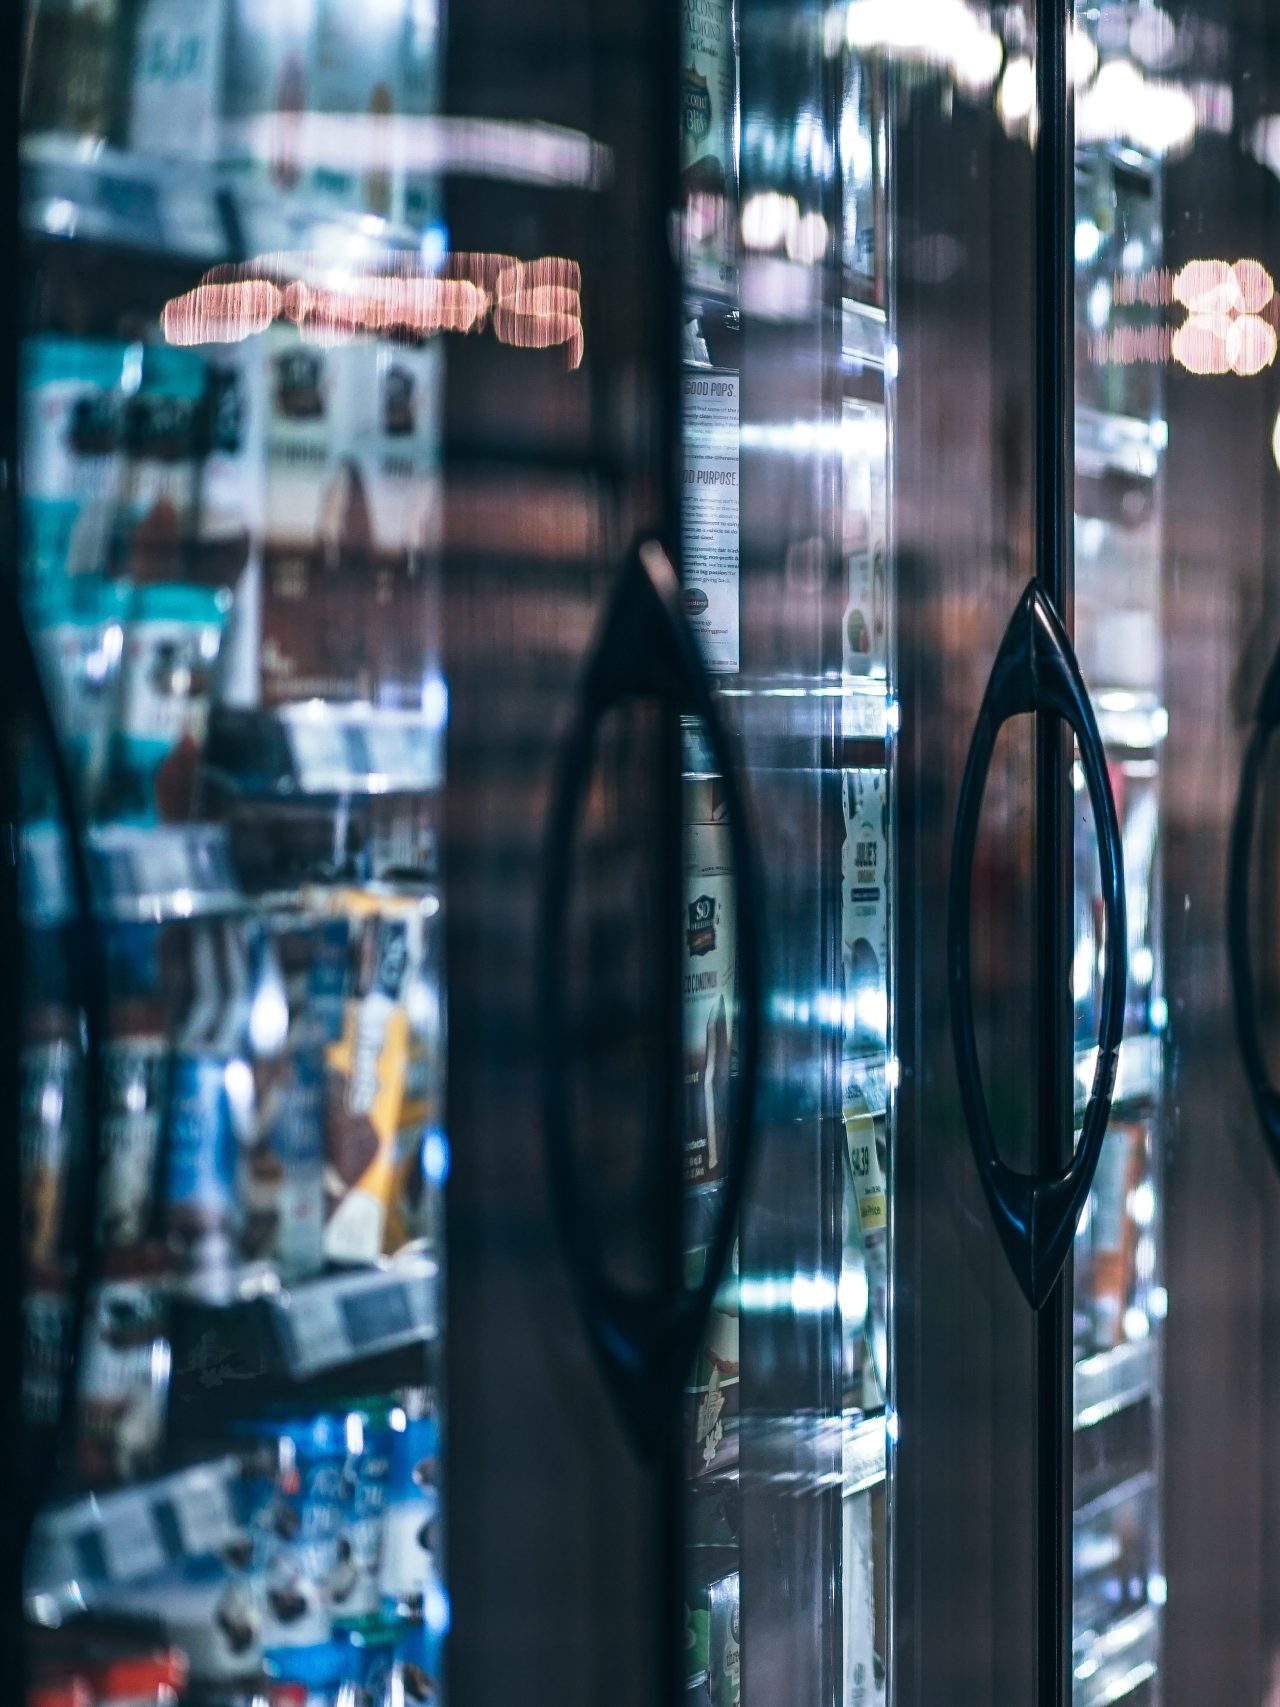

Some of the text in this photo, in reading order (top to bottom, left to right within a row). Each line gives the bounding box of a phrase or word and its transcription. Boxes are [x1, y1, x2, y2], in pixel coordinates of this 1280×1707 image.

[683, 381, 736, 398] GOOD POPS.
[697, 469, 739, 487] PURPOSE.
